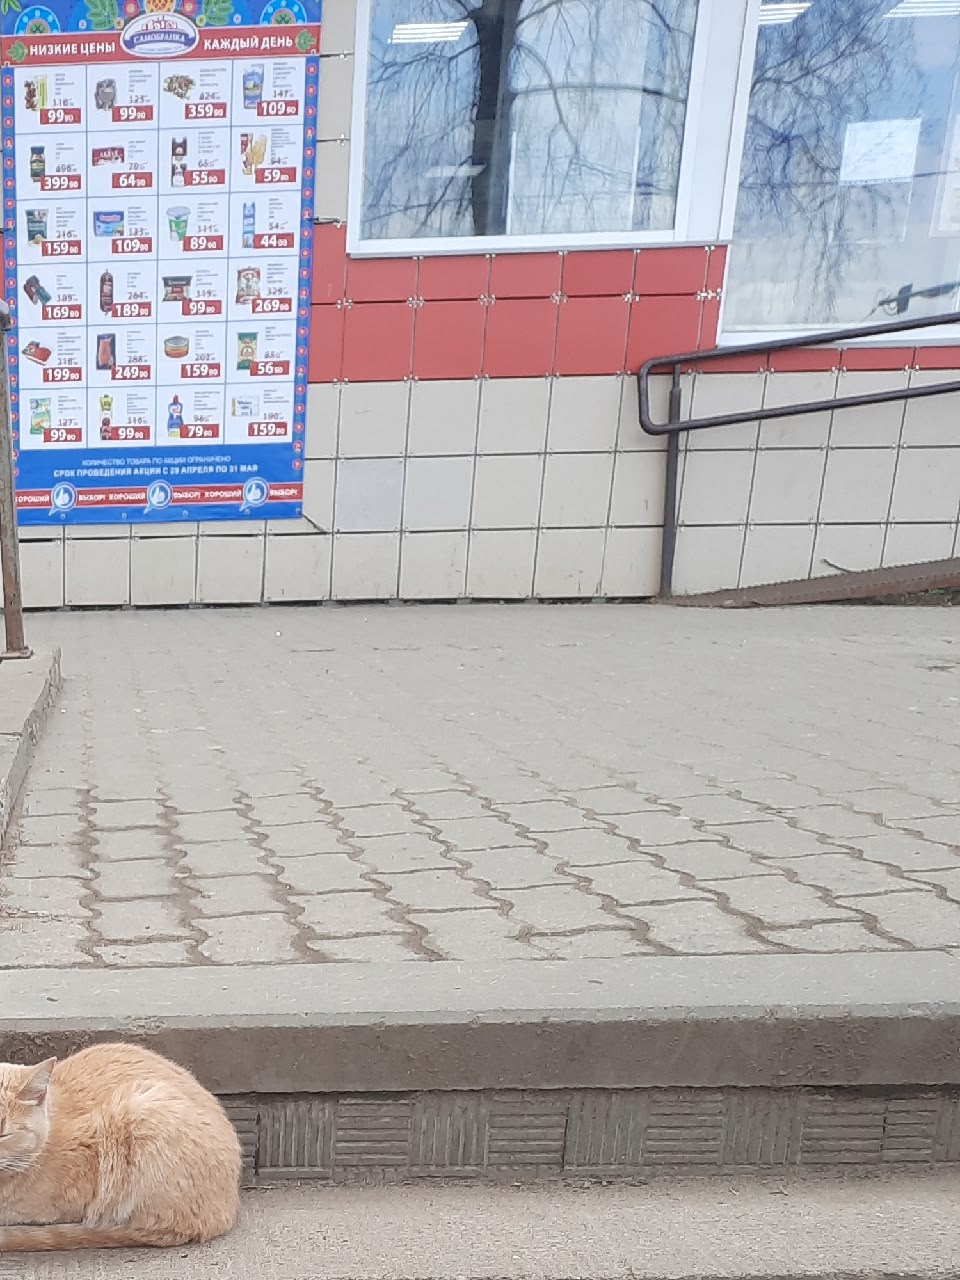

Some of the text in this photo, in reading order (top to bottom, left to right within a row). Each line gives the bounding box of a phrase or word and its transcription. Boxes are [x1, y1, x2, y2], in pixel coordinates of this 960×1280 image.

[204, 35, 293, 51] КАЖДЫЙ ДЕНЬ
[30, 42, 116, 57] НИЗКИЕ ЦЕНЫ
[120, 107, 136, 120] 99
[188, 104, 213, 117] 359
[261, 102, 286, 115] 109
[48, 110, 64, 122] 99
[119, 174, 136, 187] 64
[192, 172, 209, 184] 55
[263, 169, 280, 182] 59
[44, 176, 68, 190] 399
[116, 240, 140, 252] 109
[261, 235, 278, 247] 44
[45, 242, 68, 254] 159
[116, 304, 139, 316] 189
[189, 302, 206, 314] 99
[255, 300, 280, 312] 269
[46, 306, 69, 319] 169
[115, 366, 140, 379] 249
[185, 364, 208, 376] 159
[257, 362, 274, 374] 56
[46, 368, 70, 381] 199
[51, 429, 66, 441] 99
[118, 427, 134, 439] 99
[187, 425, 204, 437] 79
[252, 423, 276, 436] 159
[53, 469, 75, 477] СРОК
[76, 468, 132, 477] ПРОВЕДЕНИЯ
[133, 467, 161, 476] АКЦИИ
[162, 467, 169, 475] С
[181, 466, 214, 474] АПРЕЛЯ
[216, 465, 228, 473] ПО
[240, 464, 258, 472] МАЯ
